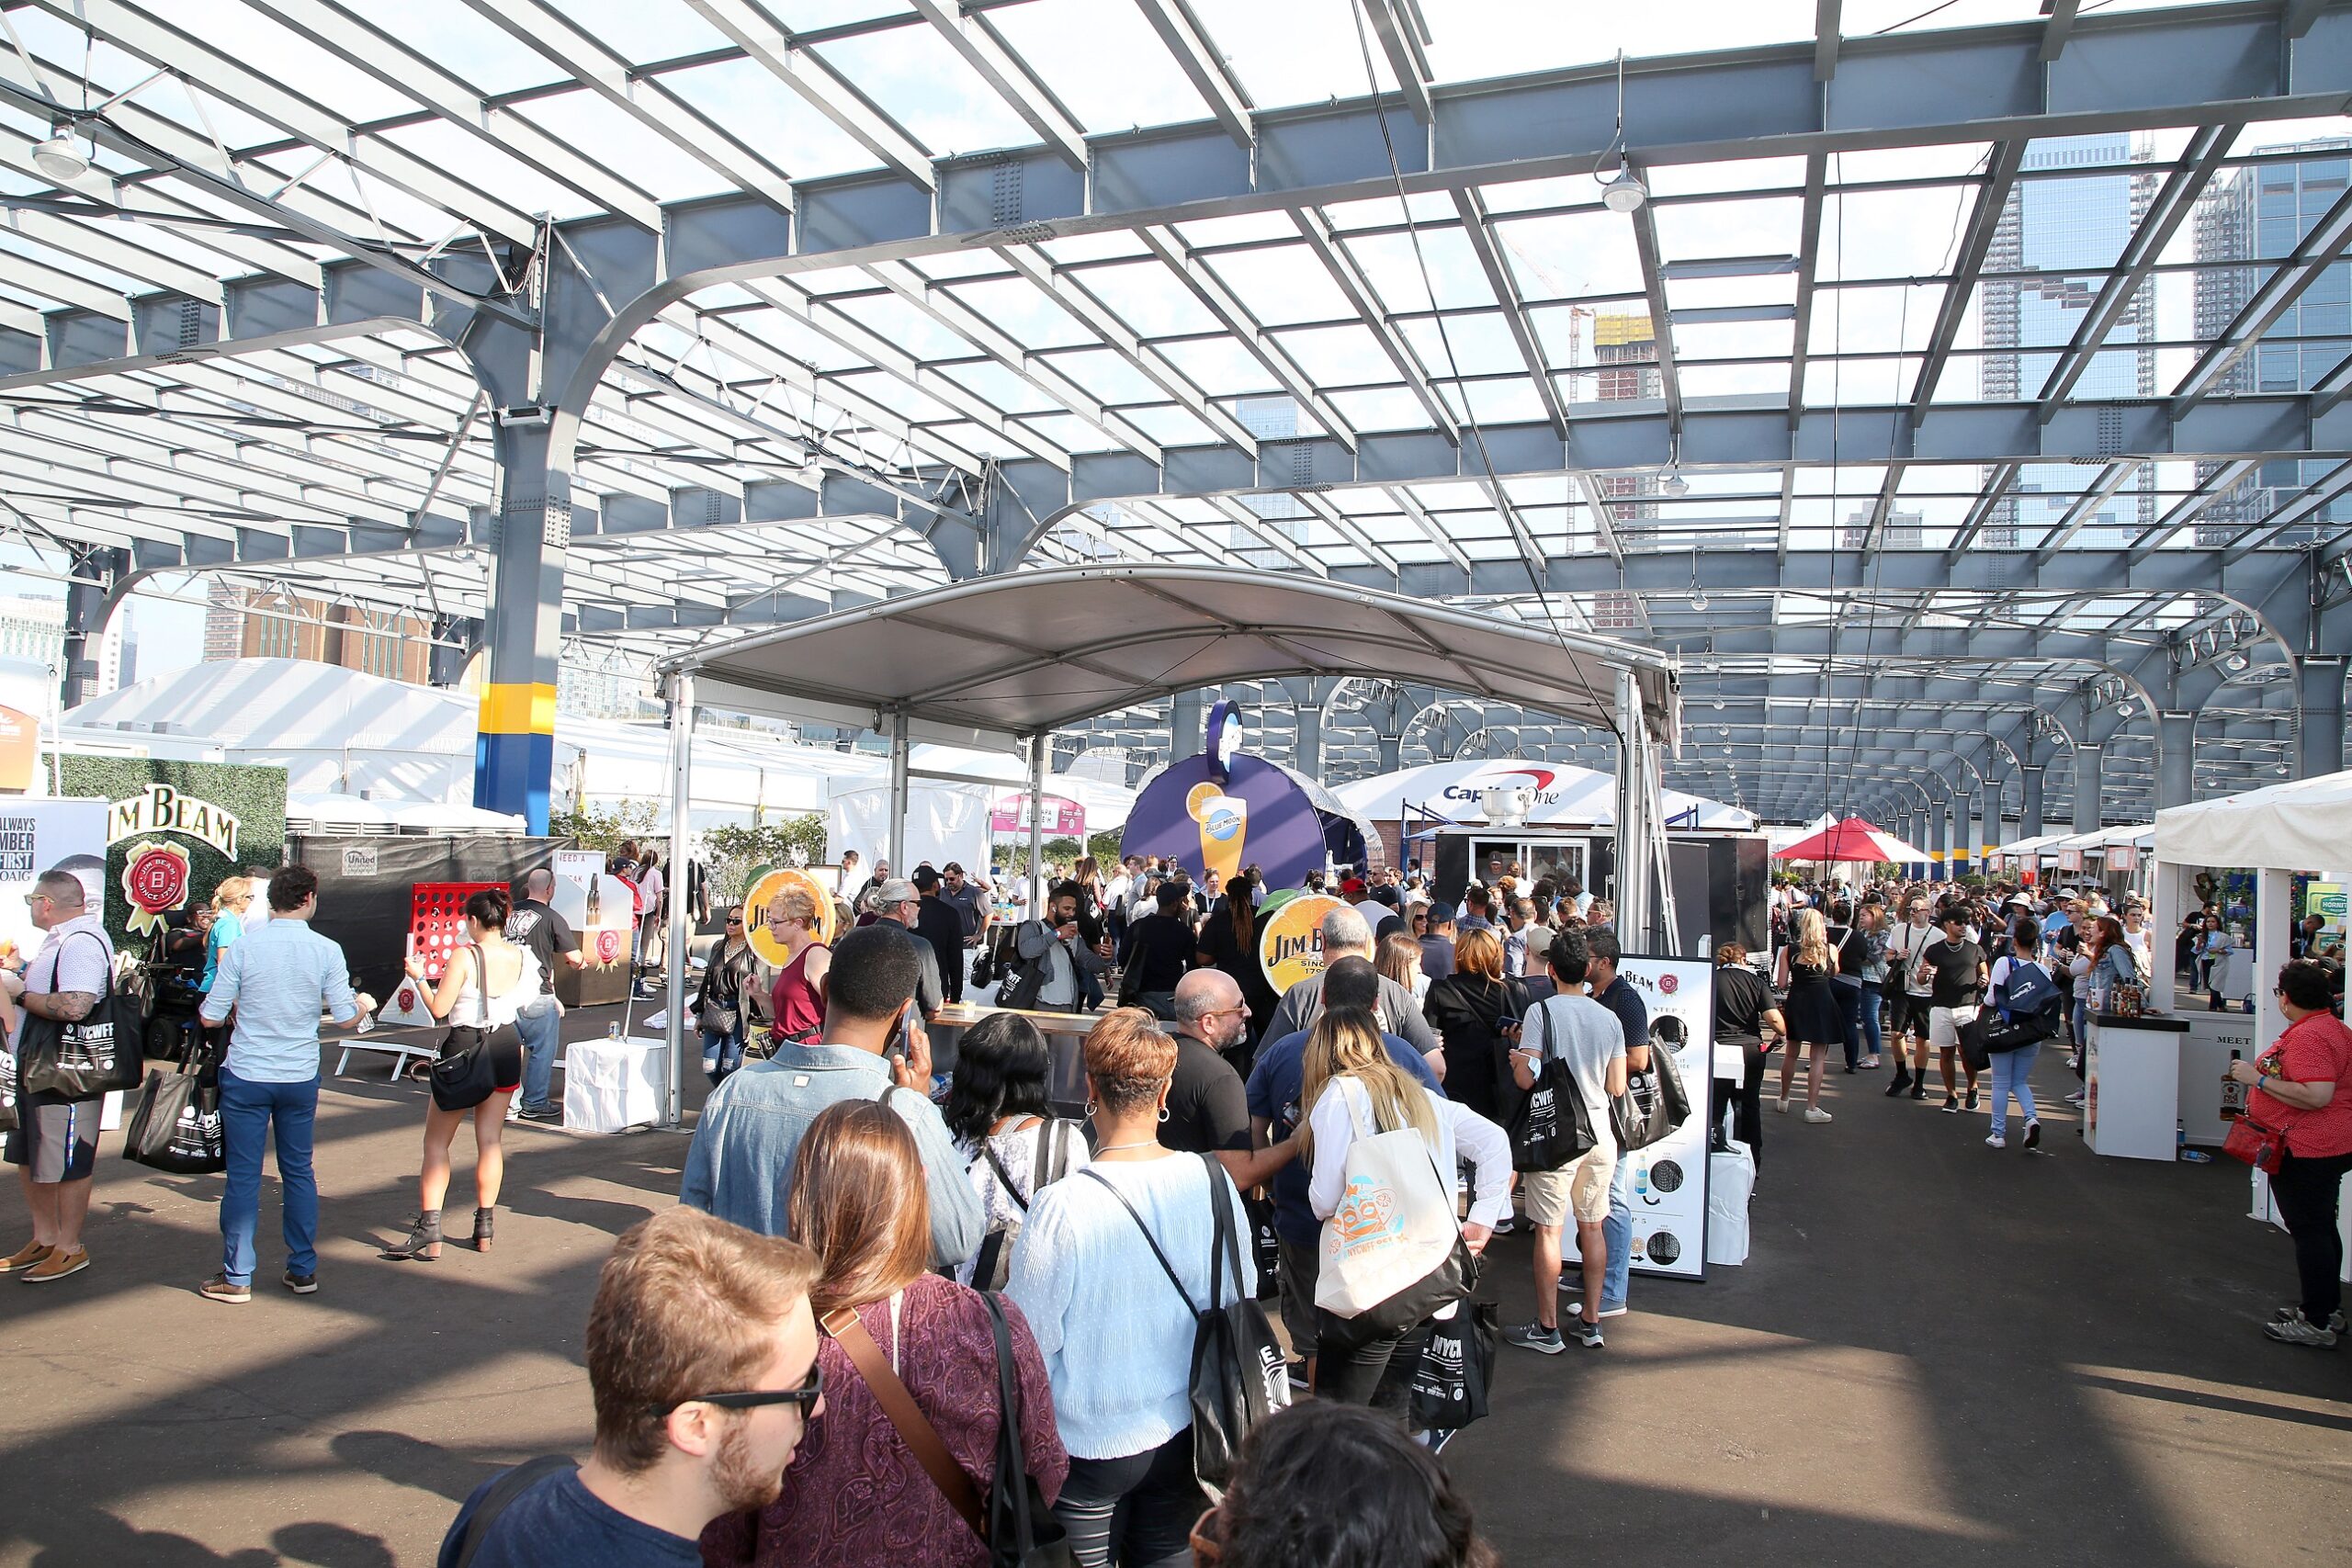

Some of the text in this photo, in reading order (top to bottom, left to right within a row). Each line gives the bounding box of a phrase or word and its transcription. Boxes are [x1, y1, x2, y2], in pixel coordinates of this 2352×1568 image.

[107, 787, 233, 852] IM BEAM
[1205, 817, 1240, 834] BLUE MOON
[141, 859, 176, 875] JIM BEAM
[348, 854, 375, 864] United
[152, 872, 164, 888] B
[139, 882, 159, 900] SINCE
[749, 904, 770, 933] JI
[1268, 934, 1306, 967] JIM
[1625, 970, 1653, 992] BEAM
[77, 1022, 114, 1039] NYCWFF
[2217, 1035, 2251, 1044] MEET
[1347, 1240, 1376, 1257] NYCWFF
